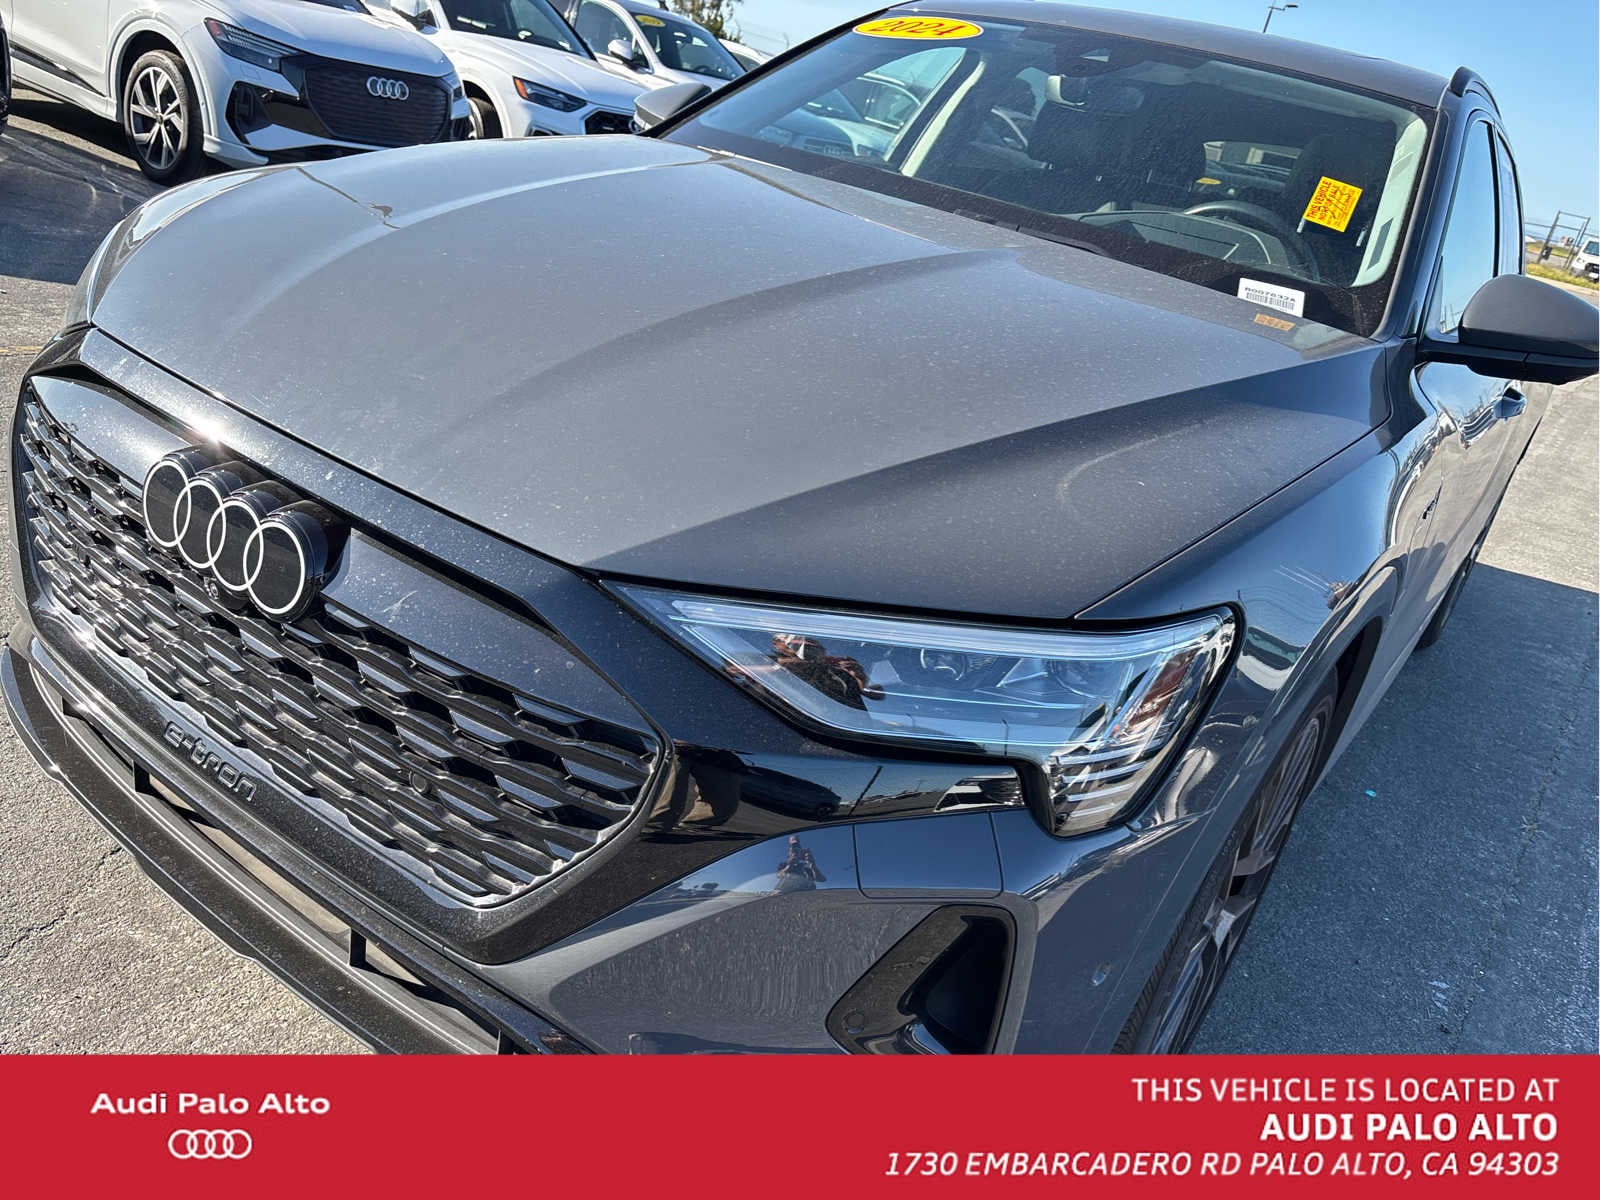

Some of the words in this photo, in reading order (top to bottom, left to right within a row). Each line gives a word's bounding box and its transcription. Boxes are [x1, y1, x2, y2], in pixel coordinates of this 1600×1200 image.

[868, 20, 967, 36] 2024
[1312, 180, 1331, 205] VEHICLE
[1306, 203, 1321, 219] THIS
[163, 720, 257, 802] e-tron
